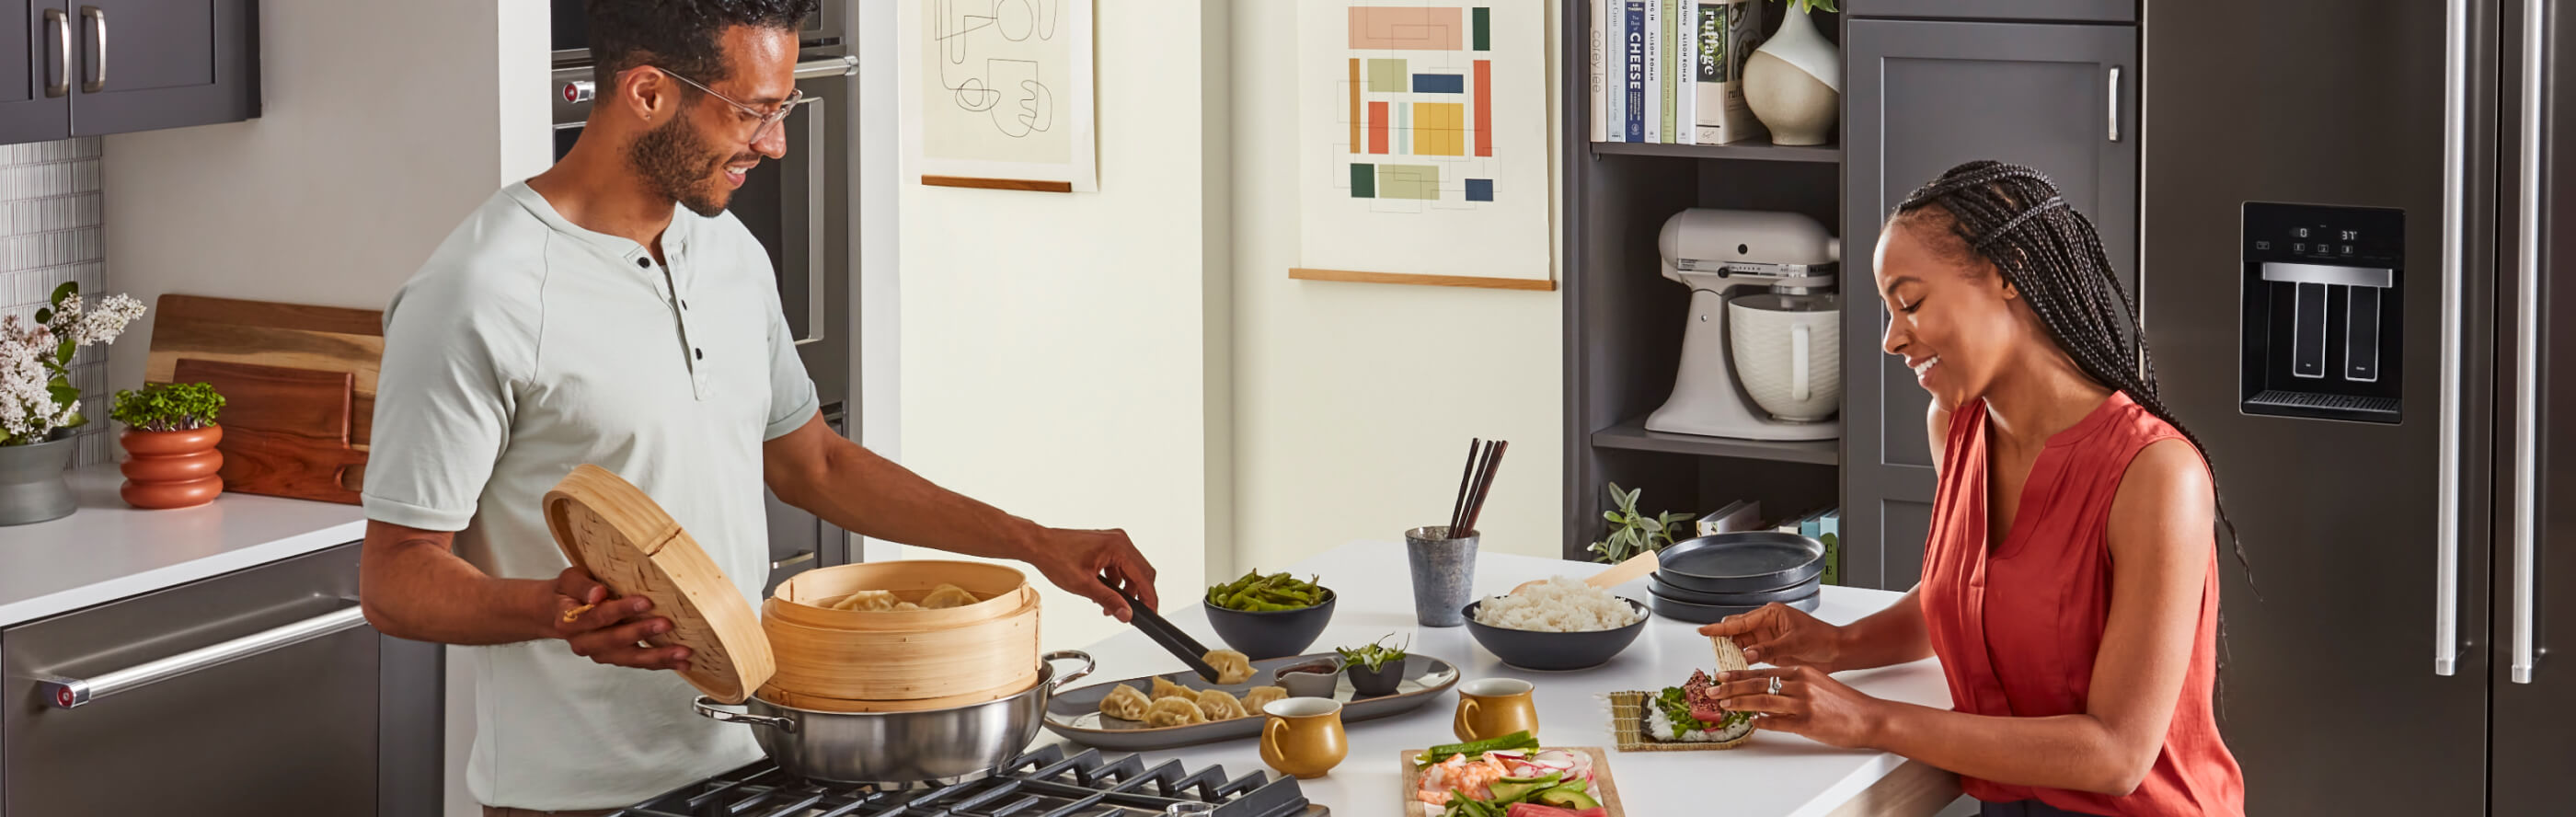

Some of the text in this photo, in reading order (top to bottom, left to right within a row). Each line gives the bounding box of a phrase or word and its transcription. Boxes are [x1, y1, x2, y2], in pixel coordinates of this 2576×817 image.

[1591, 29, 1604, 93] corey lee
[1629, 32, 1641, 89] CHEESE
[1700, 11, 1719, 75] ruffage
